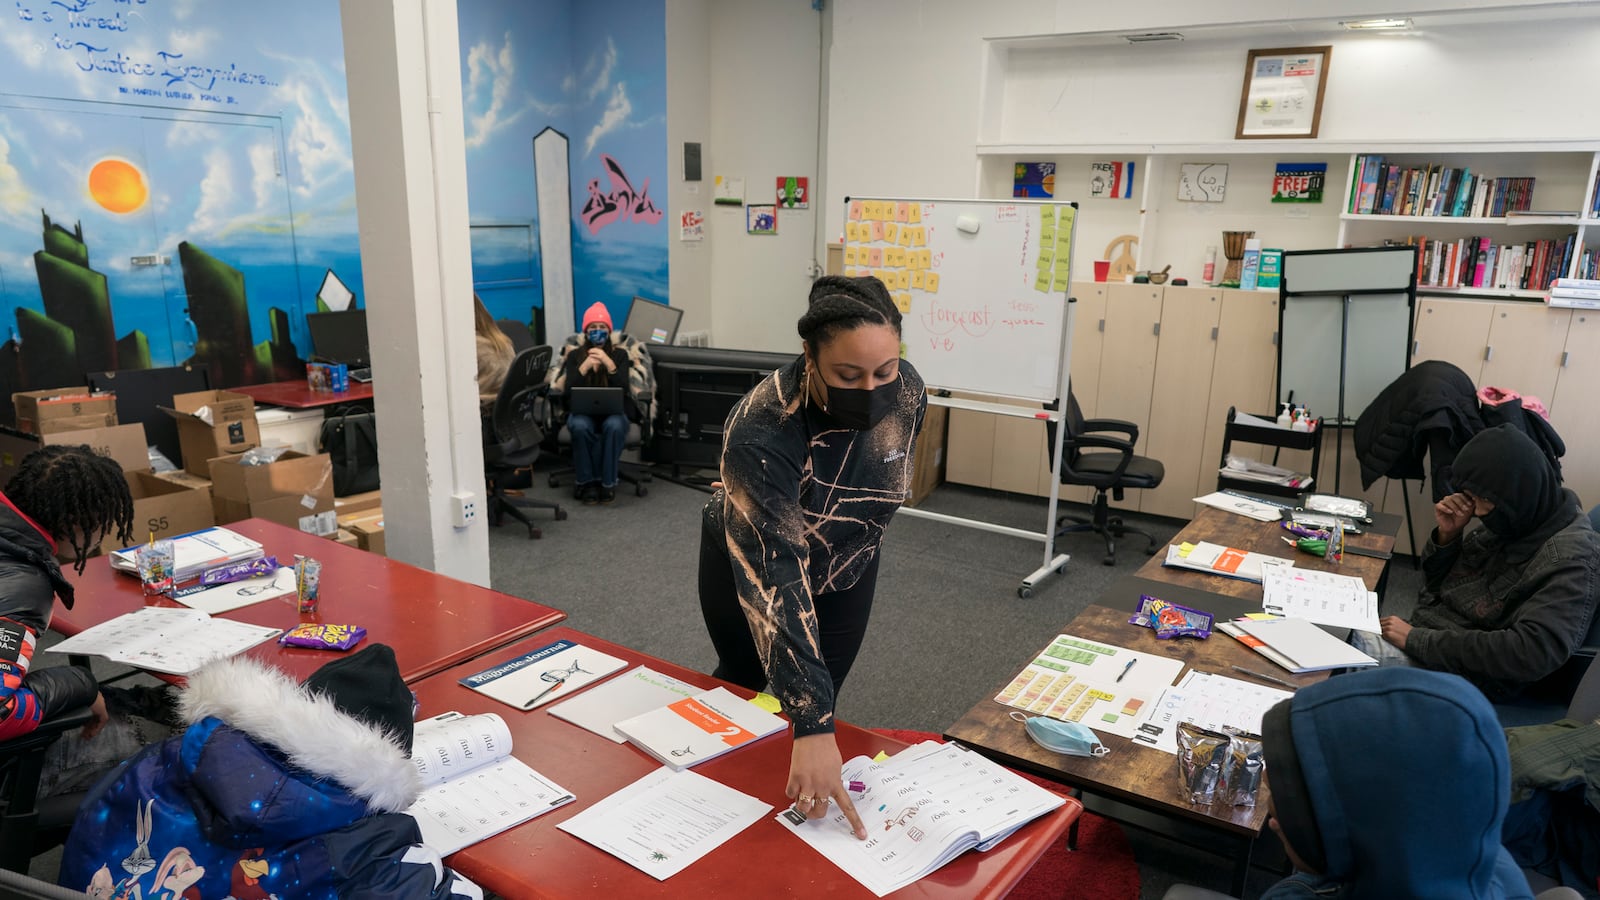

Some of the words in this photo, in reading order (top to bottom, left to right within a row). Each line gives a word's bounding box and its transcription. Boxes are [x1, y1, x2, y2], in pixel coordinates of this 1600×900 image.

[76, 41, 156, 76] Justice
[1272, 176, 1309, 195] FREE
[148, 516, 169, 532] S5
[467, 656, 525, 685] Magnetic
[524, 642, 567, 667] Journal
[865, 837, 879, 850] olt
[881, 850, 898, 863] ost
